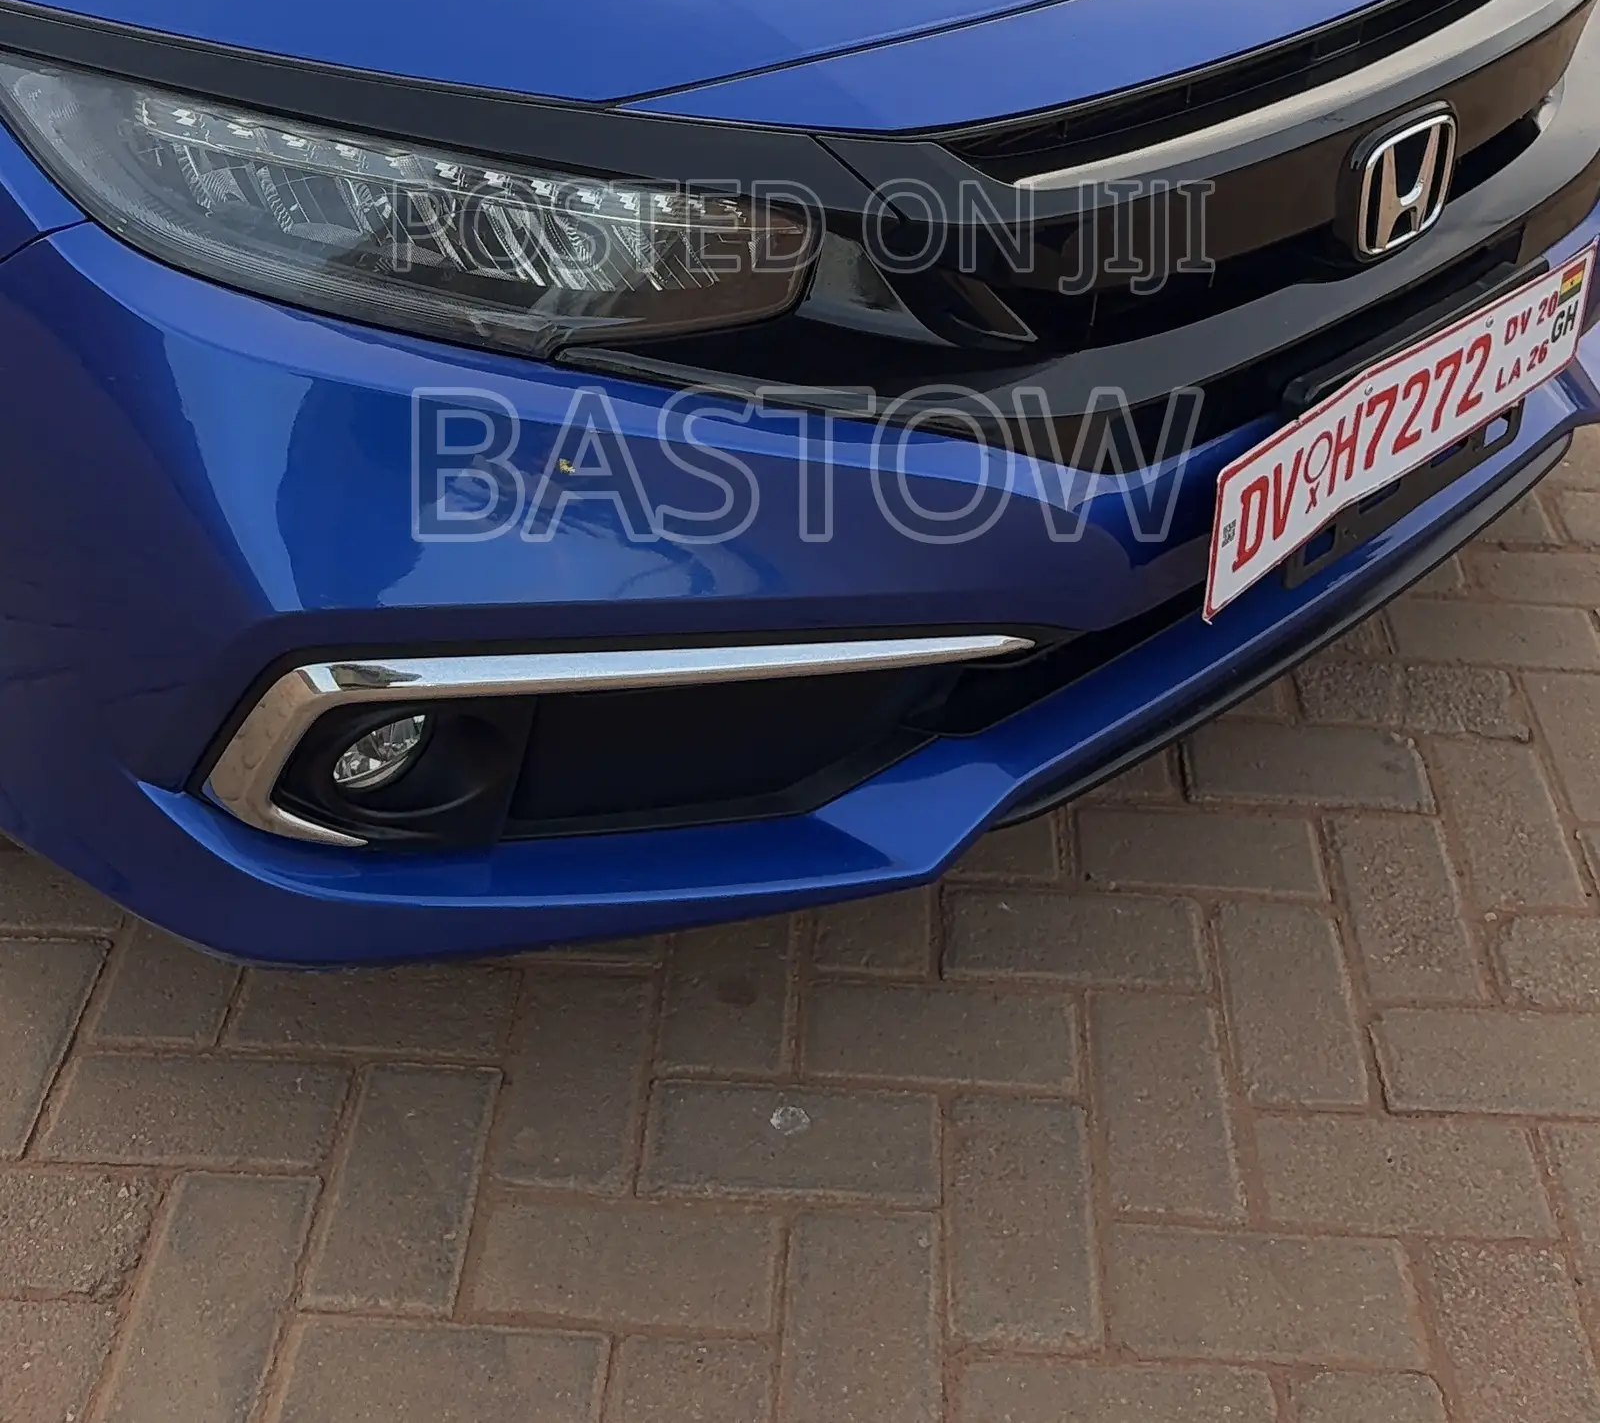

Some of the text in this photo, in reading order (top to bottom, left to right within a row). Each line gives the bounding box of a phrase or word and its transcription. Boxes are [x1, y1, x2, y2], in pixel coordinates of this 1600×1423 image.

[1504, 290, 1559, 346] DV 20
[1551, 300, 1579, 343] GH
[1495, 339, 1549, 393] LA 26
